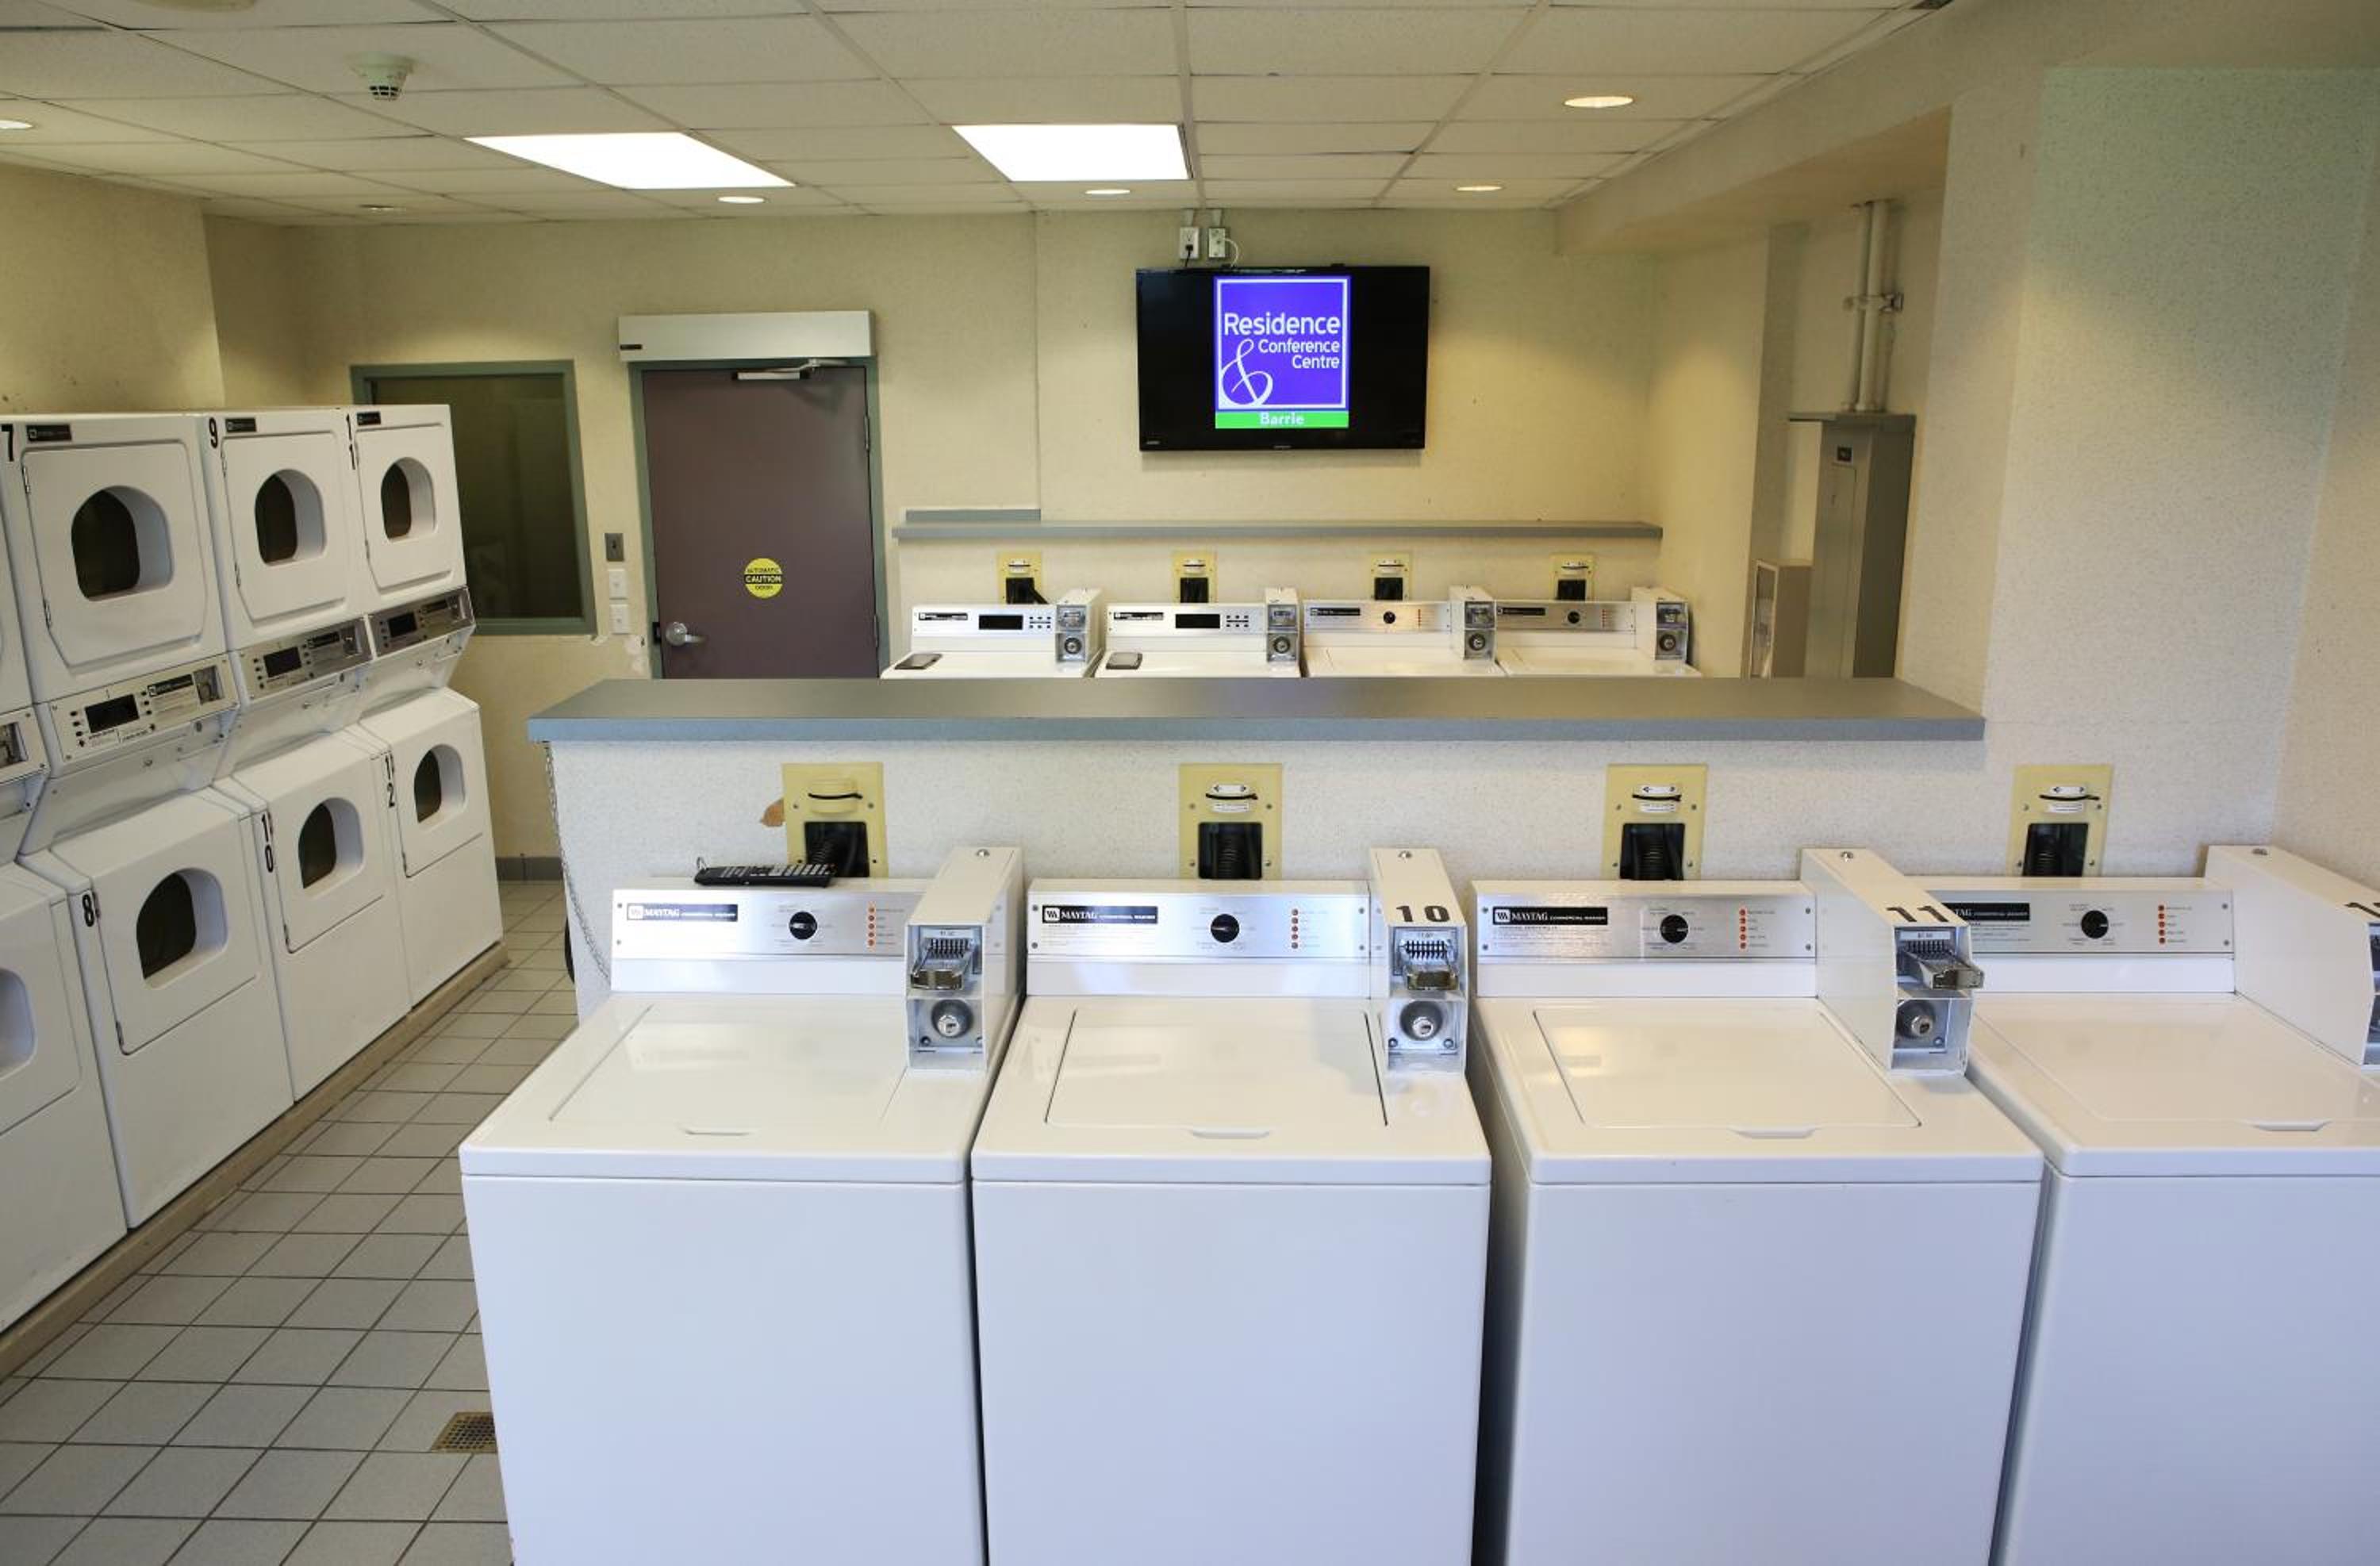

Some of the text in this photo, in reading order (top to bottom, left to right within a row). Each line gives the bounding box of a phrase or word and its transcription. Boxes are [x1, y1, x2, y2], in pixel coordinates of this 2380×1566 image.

[1224, 312, 1341, 335] Residence
[1258, 338, 1341, 353] Conference
[1292, 355, 1341, 369] Centre
[1260, 412, 1304, 425] Barrie
[209, 417, 219, 449] 9
[1, 424, 14, 462] 7
[262, 813, 274, 873] 10
[82, 894, 94, 927] 8
[644, 908, 680, 918] MAYTAG
[1396, 905, 1451, 923] 10
[1511, 912, 1548, 921] MAYTAG
[1886, 906, 1950, 923] 11
[2344, 902, 2380, 919] 1
